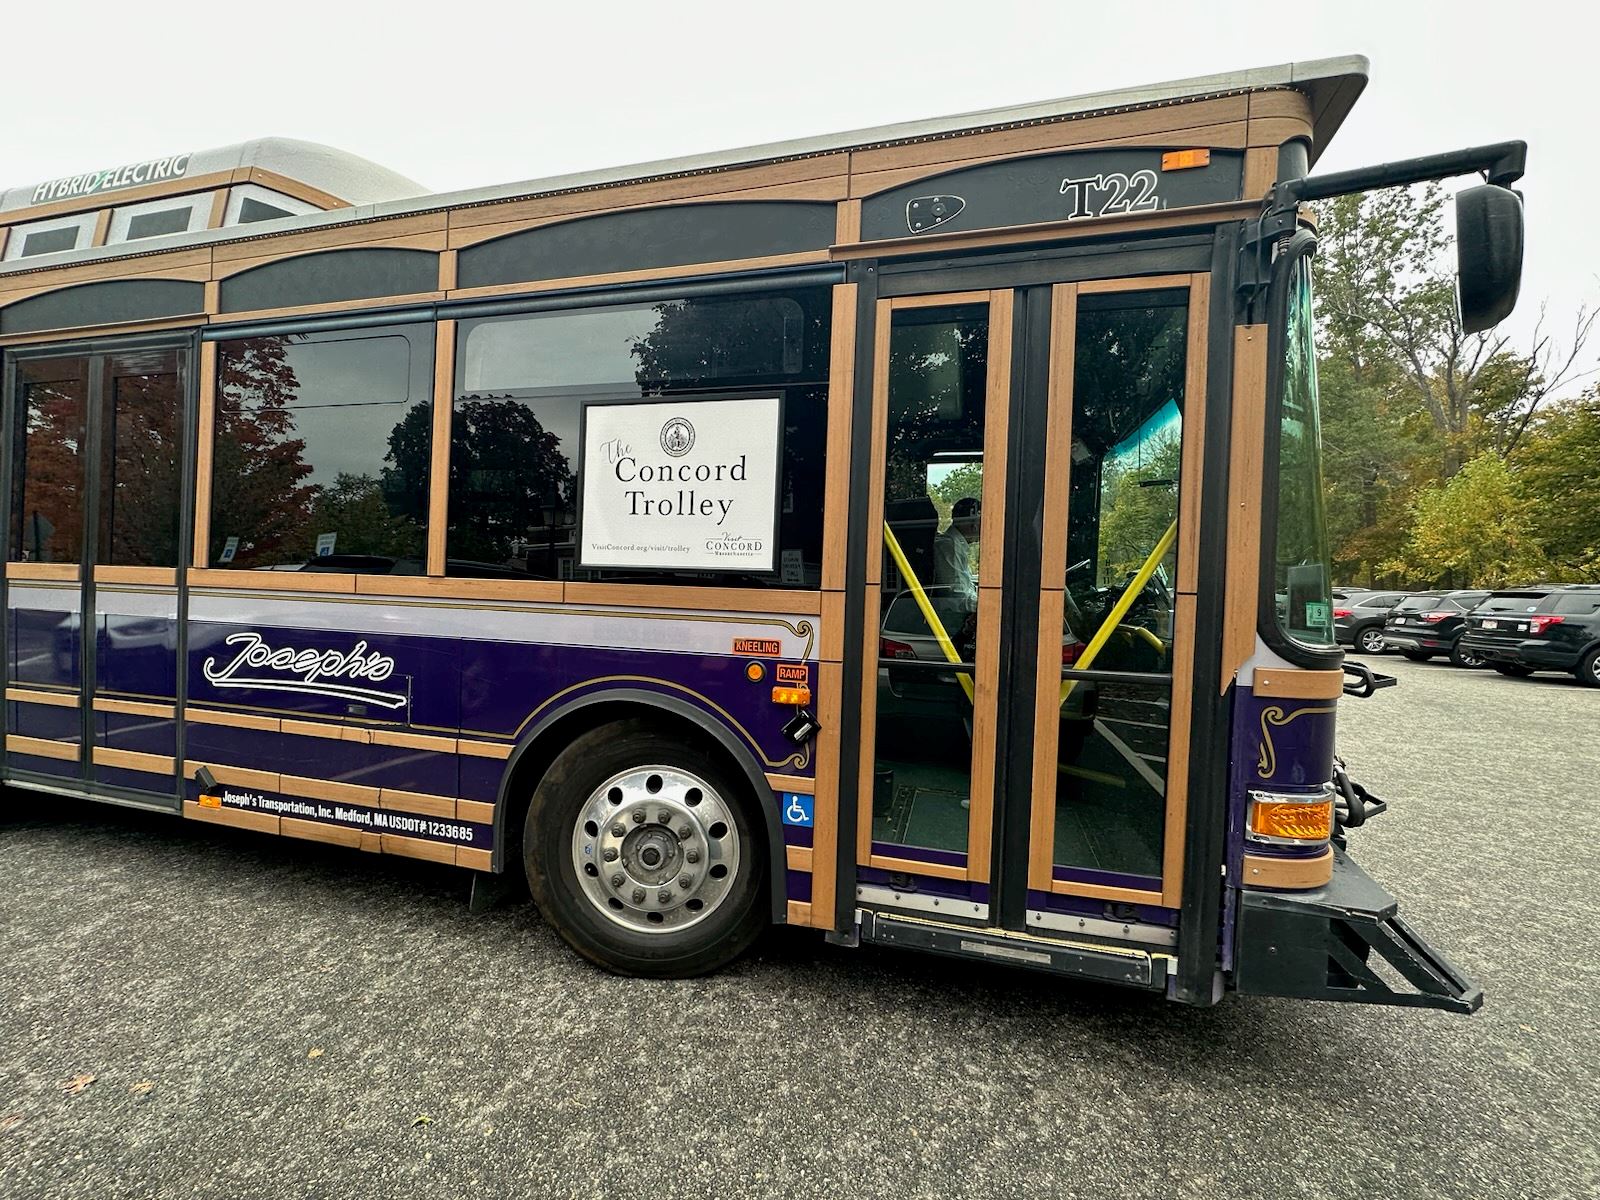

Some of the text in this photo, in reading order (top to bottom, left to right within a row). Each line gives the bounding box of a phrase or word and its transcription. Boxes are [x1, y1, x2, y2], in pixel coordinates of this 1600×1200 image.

[32, 154, 190, 201] HYBRID ELECTRIC
[1059, 169, 1158, 219] T22
[599, 438, 632, 464] The
[615, 455, 748, 482] Concord
[624, 490, 735, 525] Trolley
[591, 542, 690, 554] VisitConcord.org/visit/trolley
[705, 540, 763, 551] CONCORD
[721, 531, 743, 541] Visit
[203, 632, 395, 685] Joseph's
[736, 641, 778, 653] KNEELING
[780, 668, 806, 679] RAMP
[222, 790, 257, 806] Joseph's
[258, 796, 318, 817] Transportation,
[318, 804, 334, 819] Inc.
[335, 807, 373, 825] Medford,
[374, 813, 388, 827] MA
